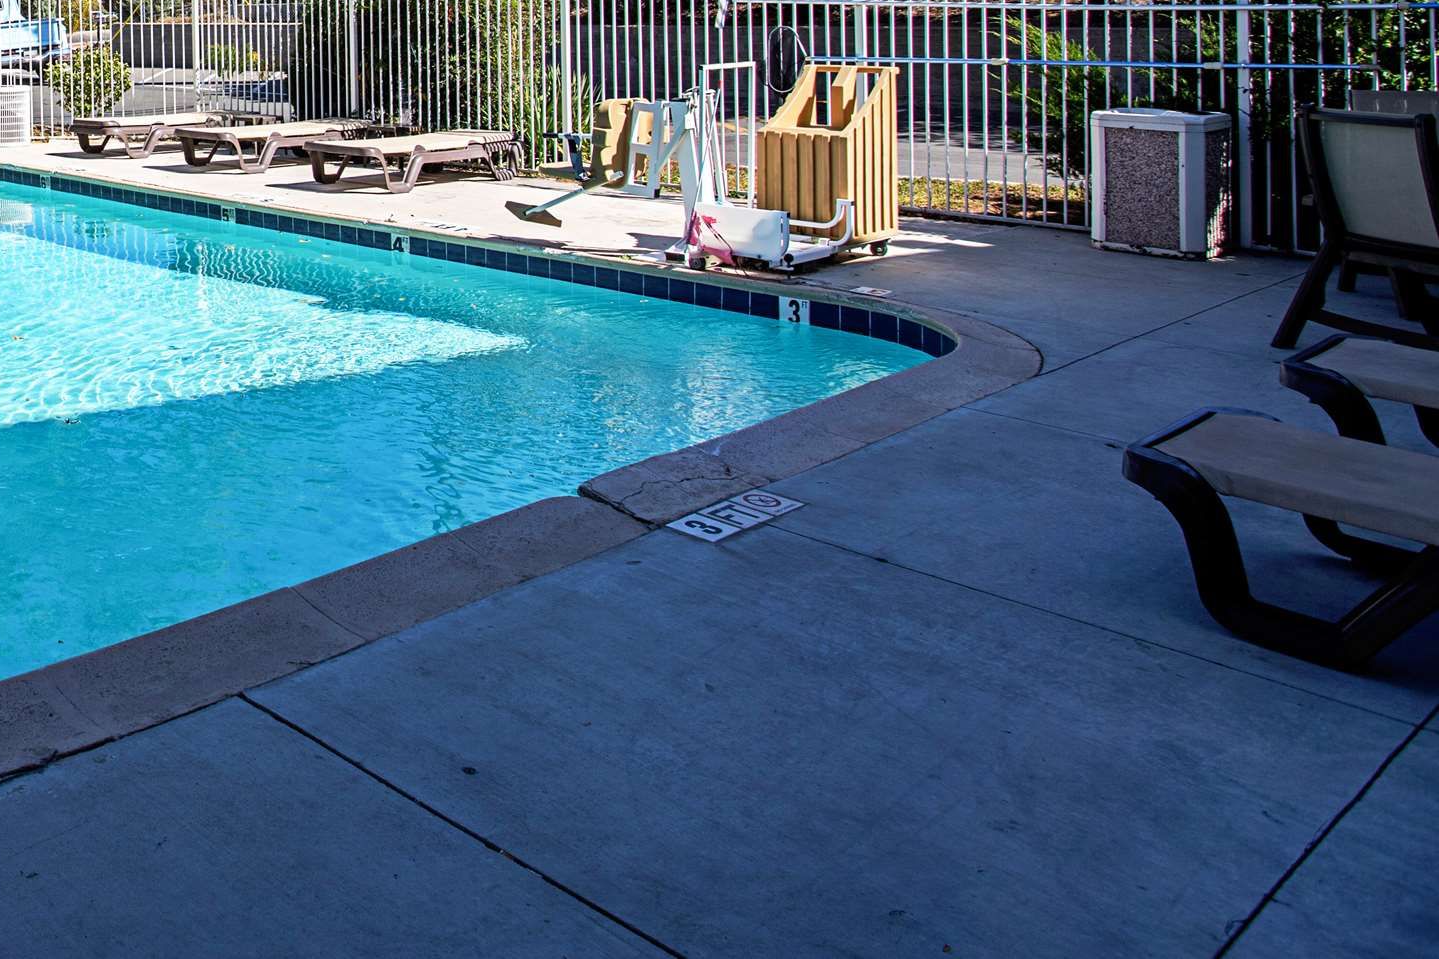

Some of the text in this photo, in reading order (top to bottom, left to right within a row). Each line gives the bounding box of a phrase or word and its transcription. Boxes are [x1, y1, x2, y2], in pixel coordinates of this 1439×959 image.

[392, 236, 405, 253] 4
[788, 299, 801, 323] 3
[684, 520, 723, 535] 3
[706, 504, 760, 526] FT
